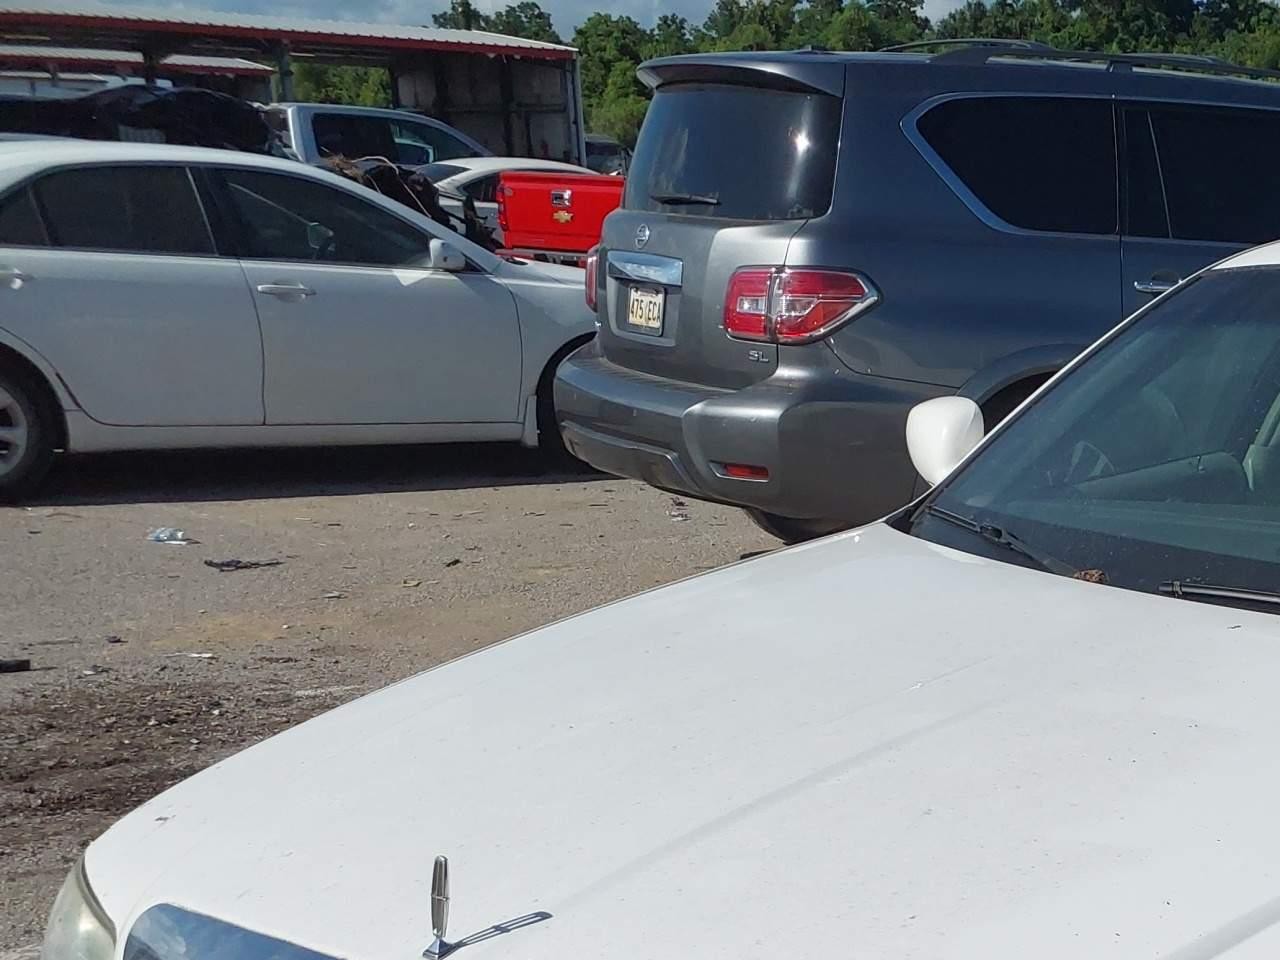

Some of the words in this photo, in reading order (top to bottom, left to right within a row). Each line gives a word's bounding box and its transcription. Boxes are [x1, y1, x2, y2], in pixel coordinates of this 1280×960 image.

[630, 298, 644, 320] 475
[647, 300, 661, 322] ECA
[748, 350, 769, 362] SL
